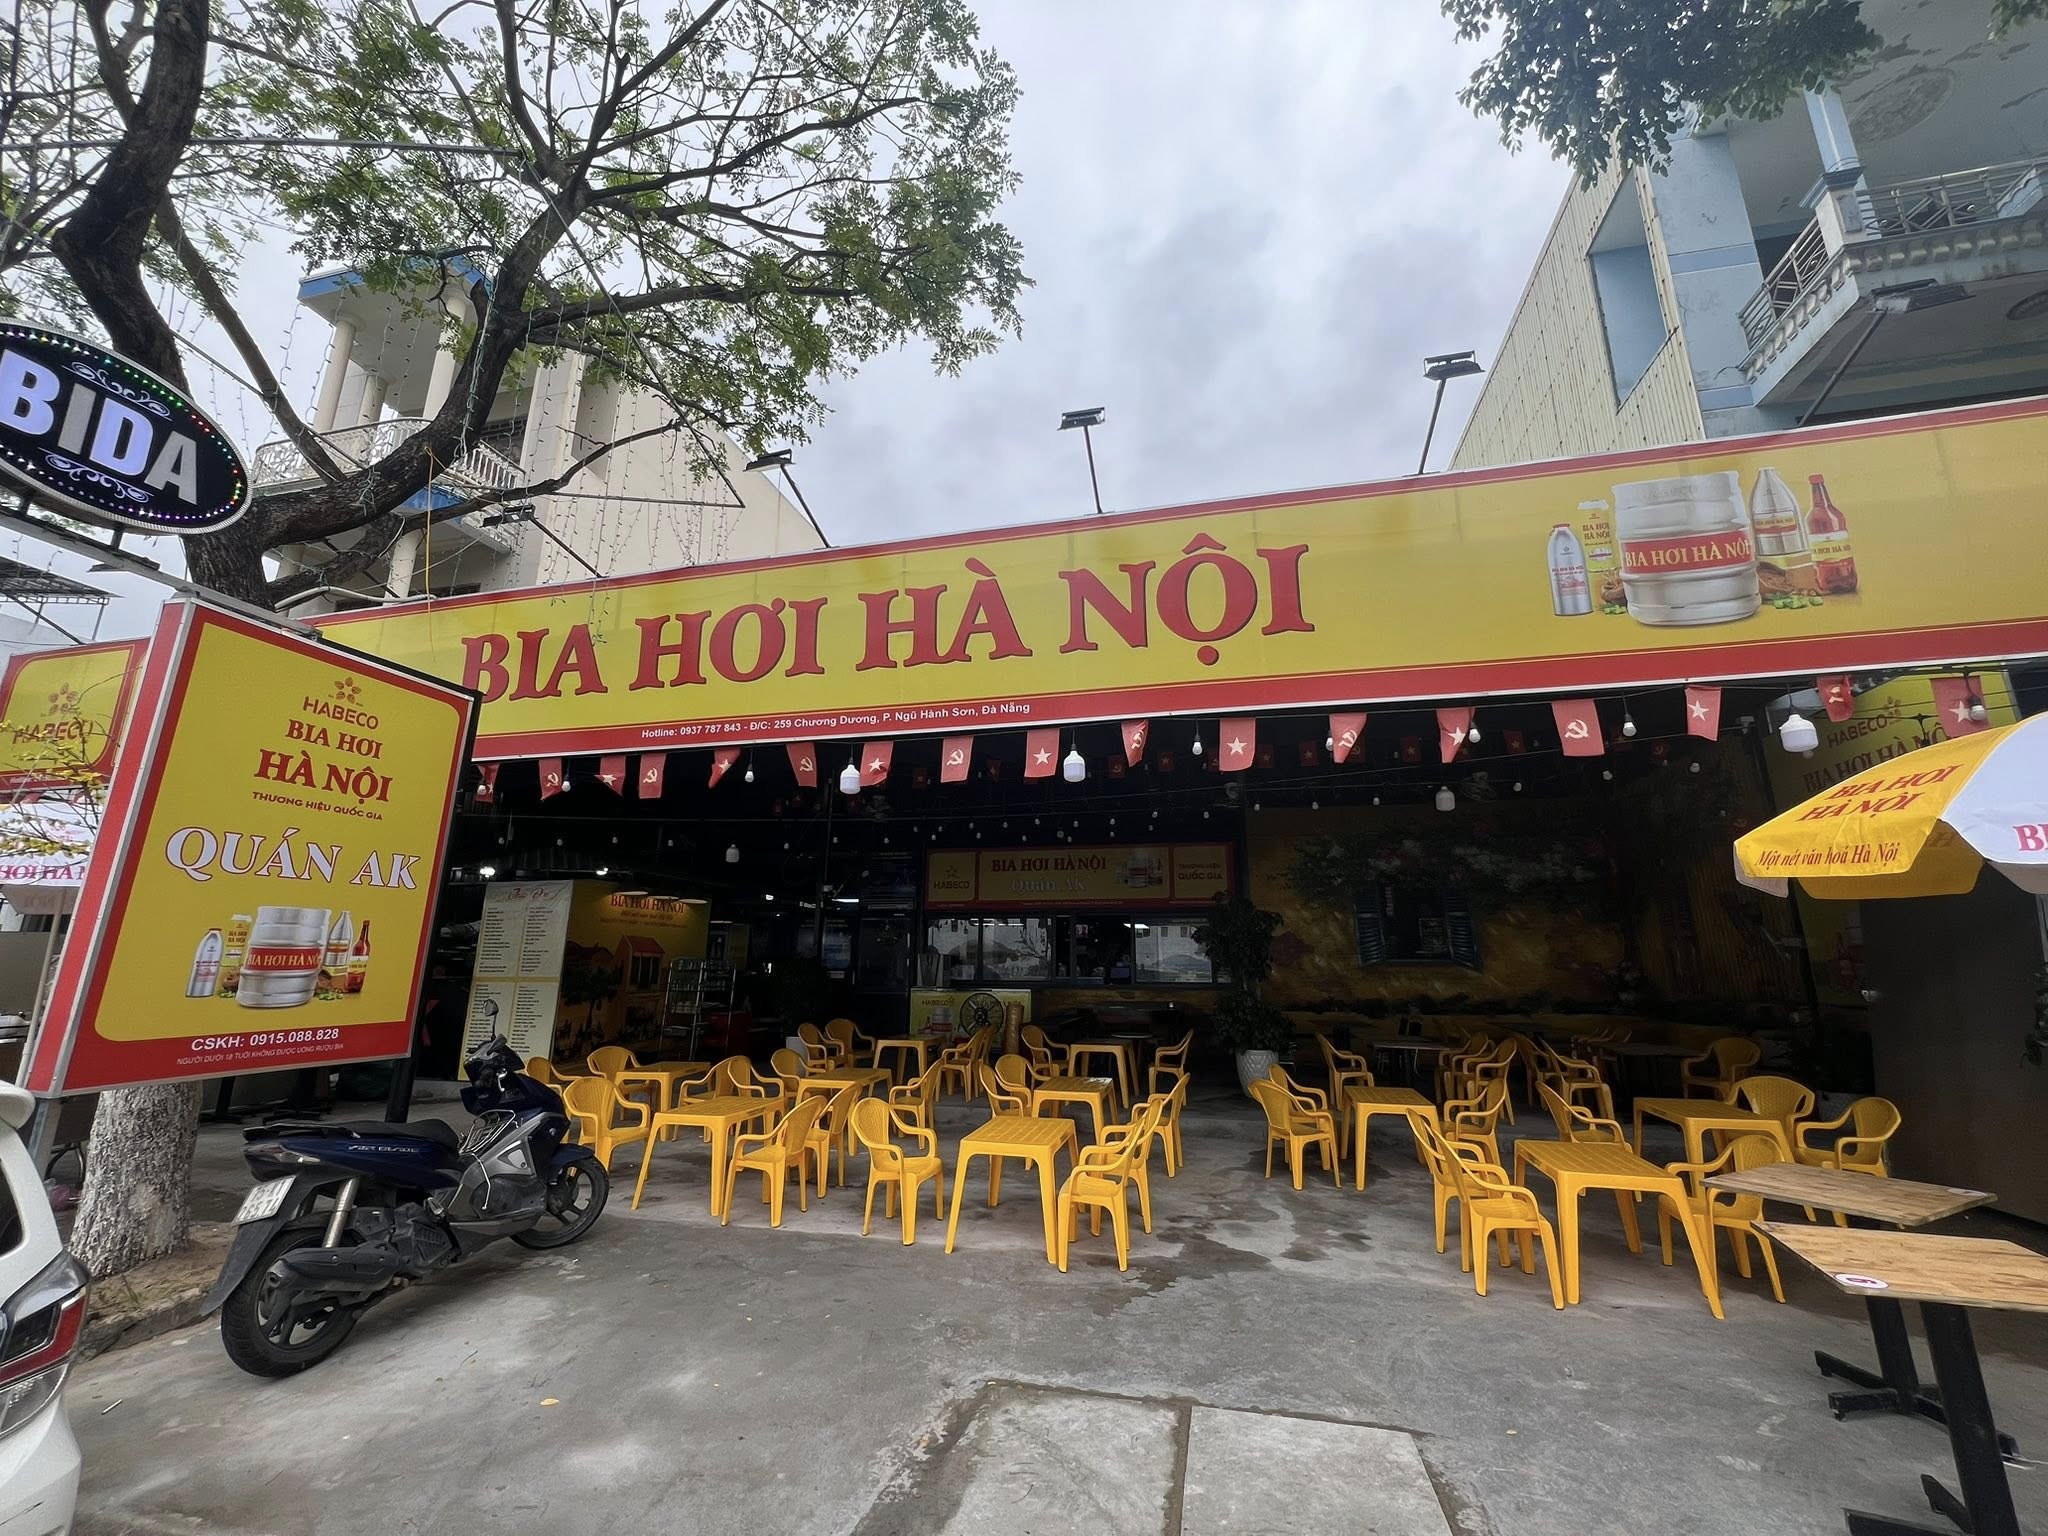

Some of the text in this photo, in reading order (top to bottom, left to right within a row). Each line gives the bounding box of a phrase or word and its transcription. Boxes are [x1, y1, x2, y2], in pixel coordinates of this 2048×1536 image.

[0, 349, 198, 505] BIDA
[1625, 552, 1648, 567] BIA
[1651, 548, 1689, 565] HƠI
[1691, 541, 1722, 562] HÀ
[461, 532, 1315, 703] BIA HƠI HÀ NỘI
[302, 696, 379, 730] HABECO
[641, 728, 677, 739] Hotline:
[680, 725, 702, 736] 0937
[704, 724, 721, 734] 787
[724, 723, 741, 733] 843
[750, 721, 771, 731] Đ/C:
[774, 720, 791, 729] 259
[794, 718, 837, 727] Chương
[840, 715, 880, 726] Dương,
[883, 712, 891, 722] P.
[895, 710, 917, 723] Ngũ
[920, 709, 948, 720] Hành
[952, 706, 978, 718] Sơn,
[982, 704, 997, 715] Đà
[285, 719, 383, 760] BIA HƠI
[1827, 713, 1888, 748] HABECO
[254, 748, 393, 805] HÀ NỘI
[1824, 780, 1886, 800] BIA
[252, 791, 383, 821] THƯƠNG HIỆU QUỐC GIA
[1795, 792, 1926, 822] HÀ NỘI
[165, 826, 421, 890] QUÁN AK
[991, 858, 1017, 872] BIA
[1755, 849, 1781, 870] Một
[1781, 848, 1800, 866] nét
[1851, 843, 1872, 864] Hà
[1873, 842, 1900, 867] Nội
[191, 1028, 339, 1051] CSKH: 0915.088.828
